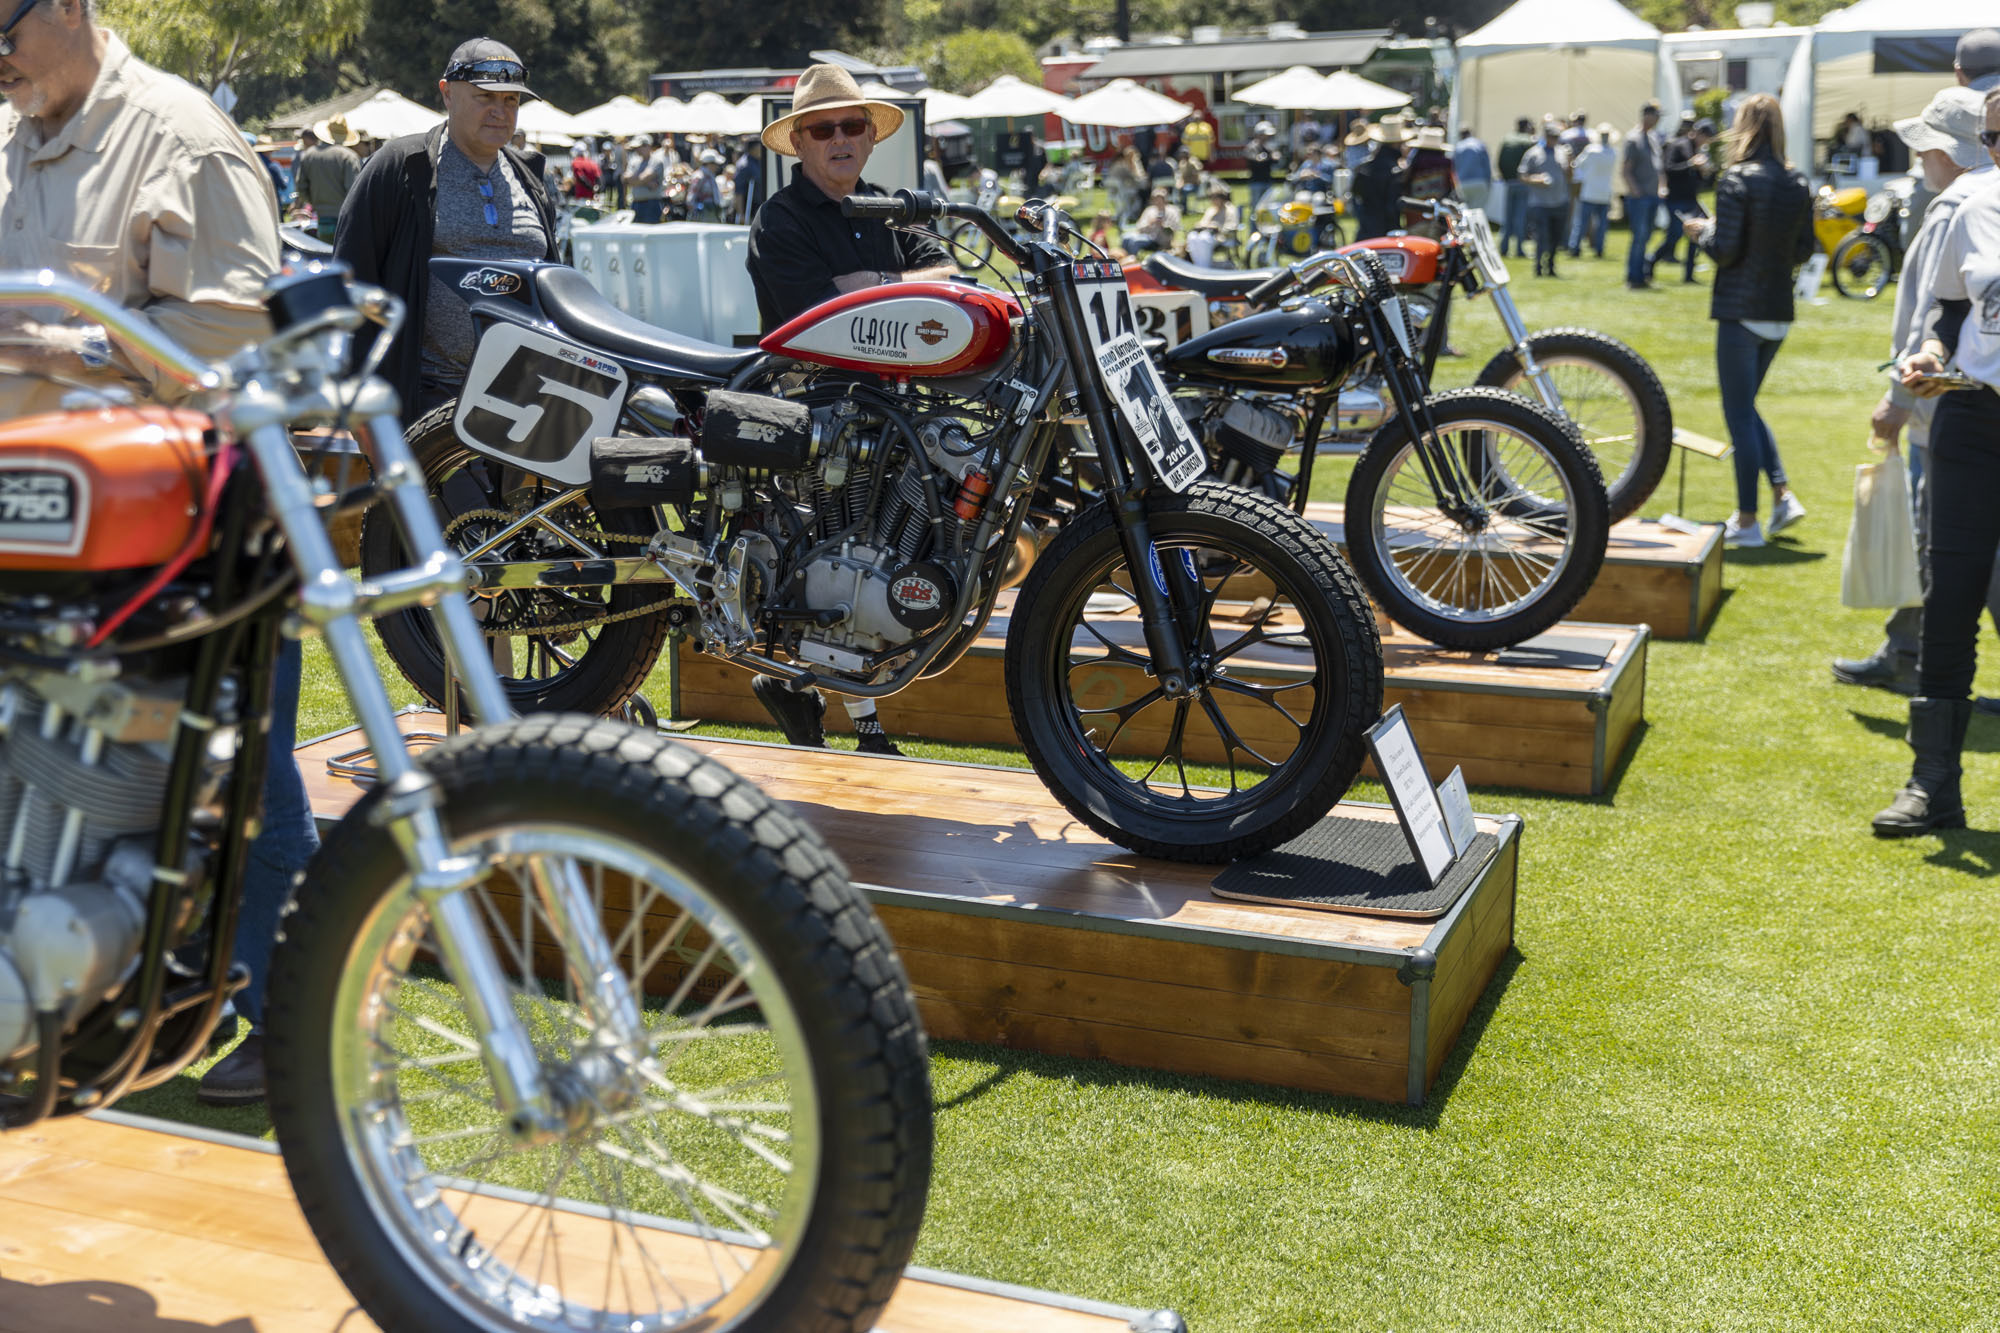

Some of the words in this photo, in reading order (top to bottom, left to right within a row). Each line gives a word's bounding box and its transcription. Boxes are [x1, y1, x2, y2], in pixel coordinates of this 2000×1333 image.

[482, 274, 515, 288] Kyle
[850, 316, 909, 350] CLASSIC
[1098, 348, 1118, 369] GRAND
[1115, 337, 1140, 360] NATIONAL
[1104, 348, 1145, 377] CHAMPION
[462, 344, 623, 463] 5
[1165, 444, 1187, 467] 2010
[1168, 469, 1185, 489] JAKE
[1179, 453, 1203, 480] JOHNSON
[0, 493, 69, 519] 750
